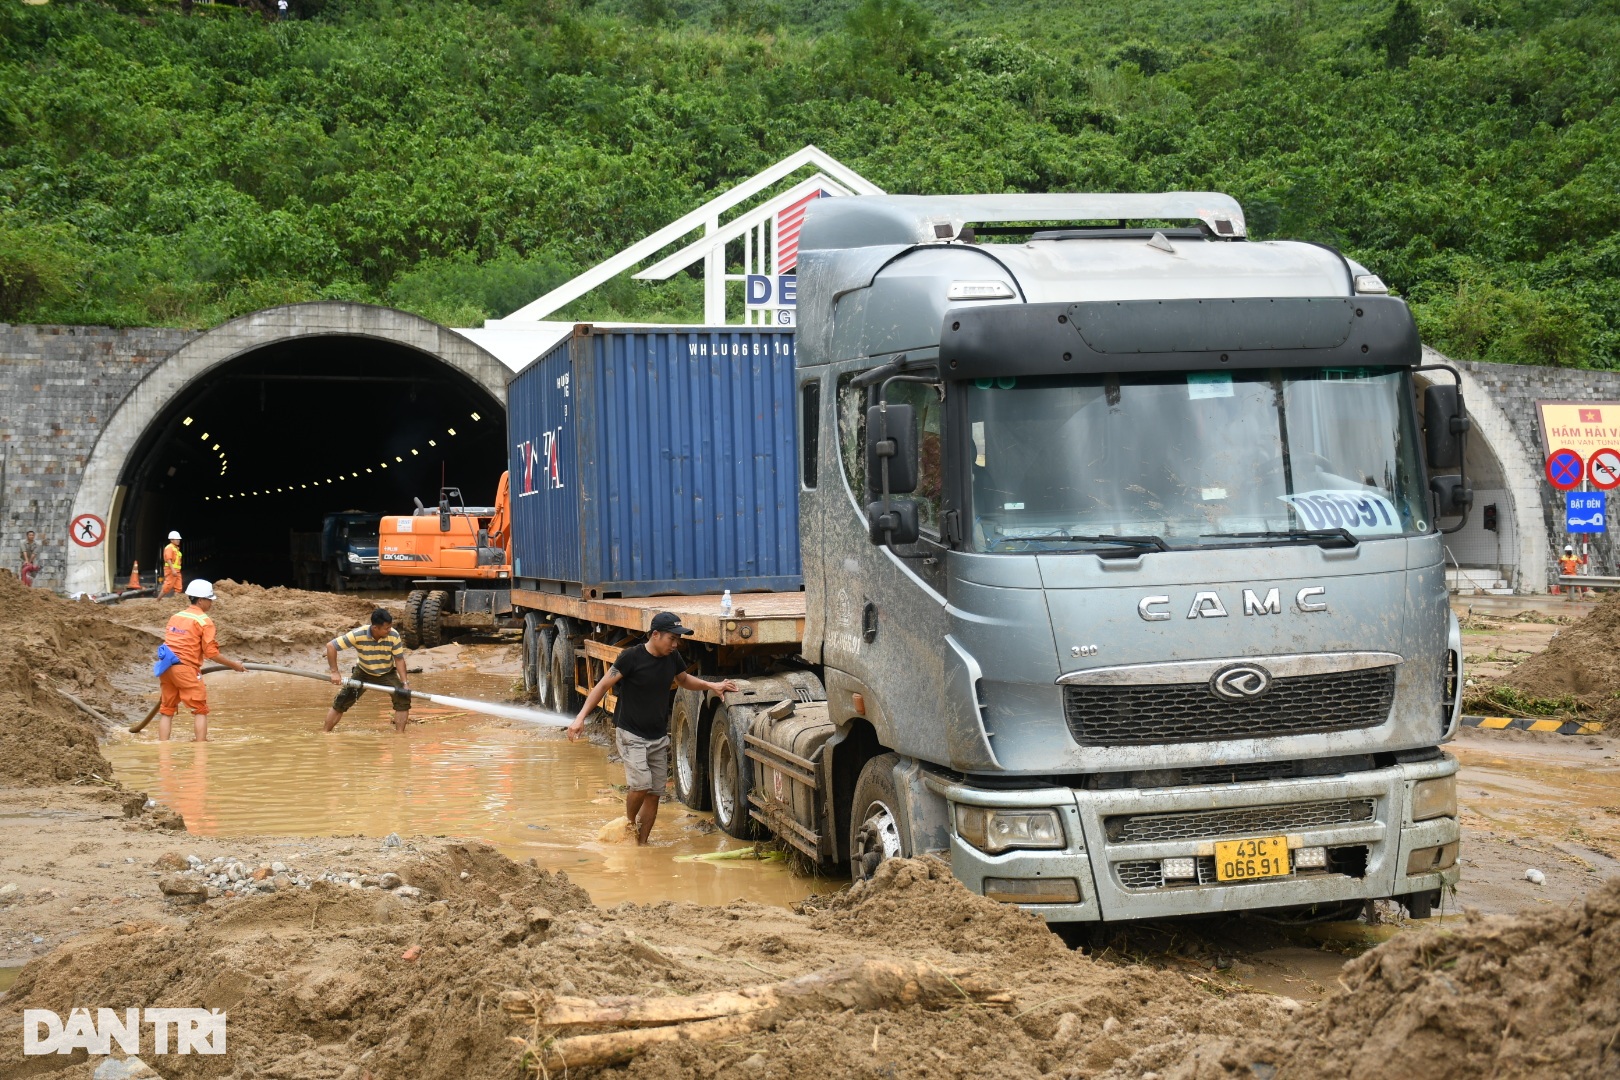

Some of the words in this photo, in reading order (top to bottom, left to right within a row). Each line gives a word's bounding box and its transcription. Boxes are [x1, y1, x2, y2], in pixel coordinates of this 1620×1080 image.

[1609, 427, 1620, 437] V
[1570, 498, 1584, 509] BẬT
[1586, 498, 1601, 509] ĐÈN
[1137, 586, 1327, 621] CAMC
[1071, 644, 1099, 659] 380
[1237, 840, 1267, 858] 43C
[1225, 858, 1280, 878] 066.91
